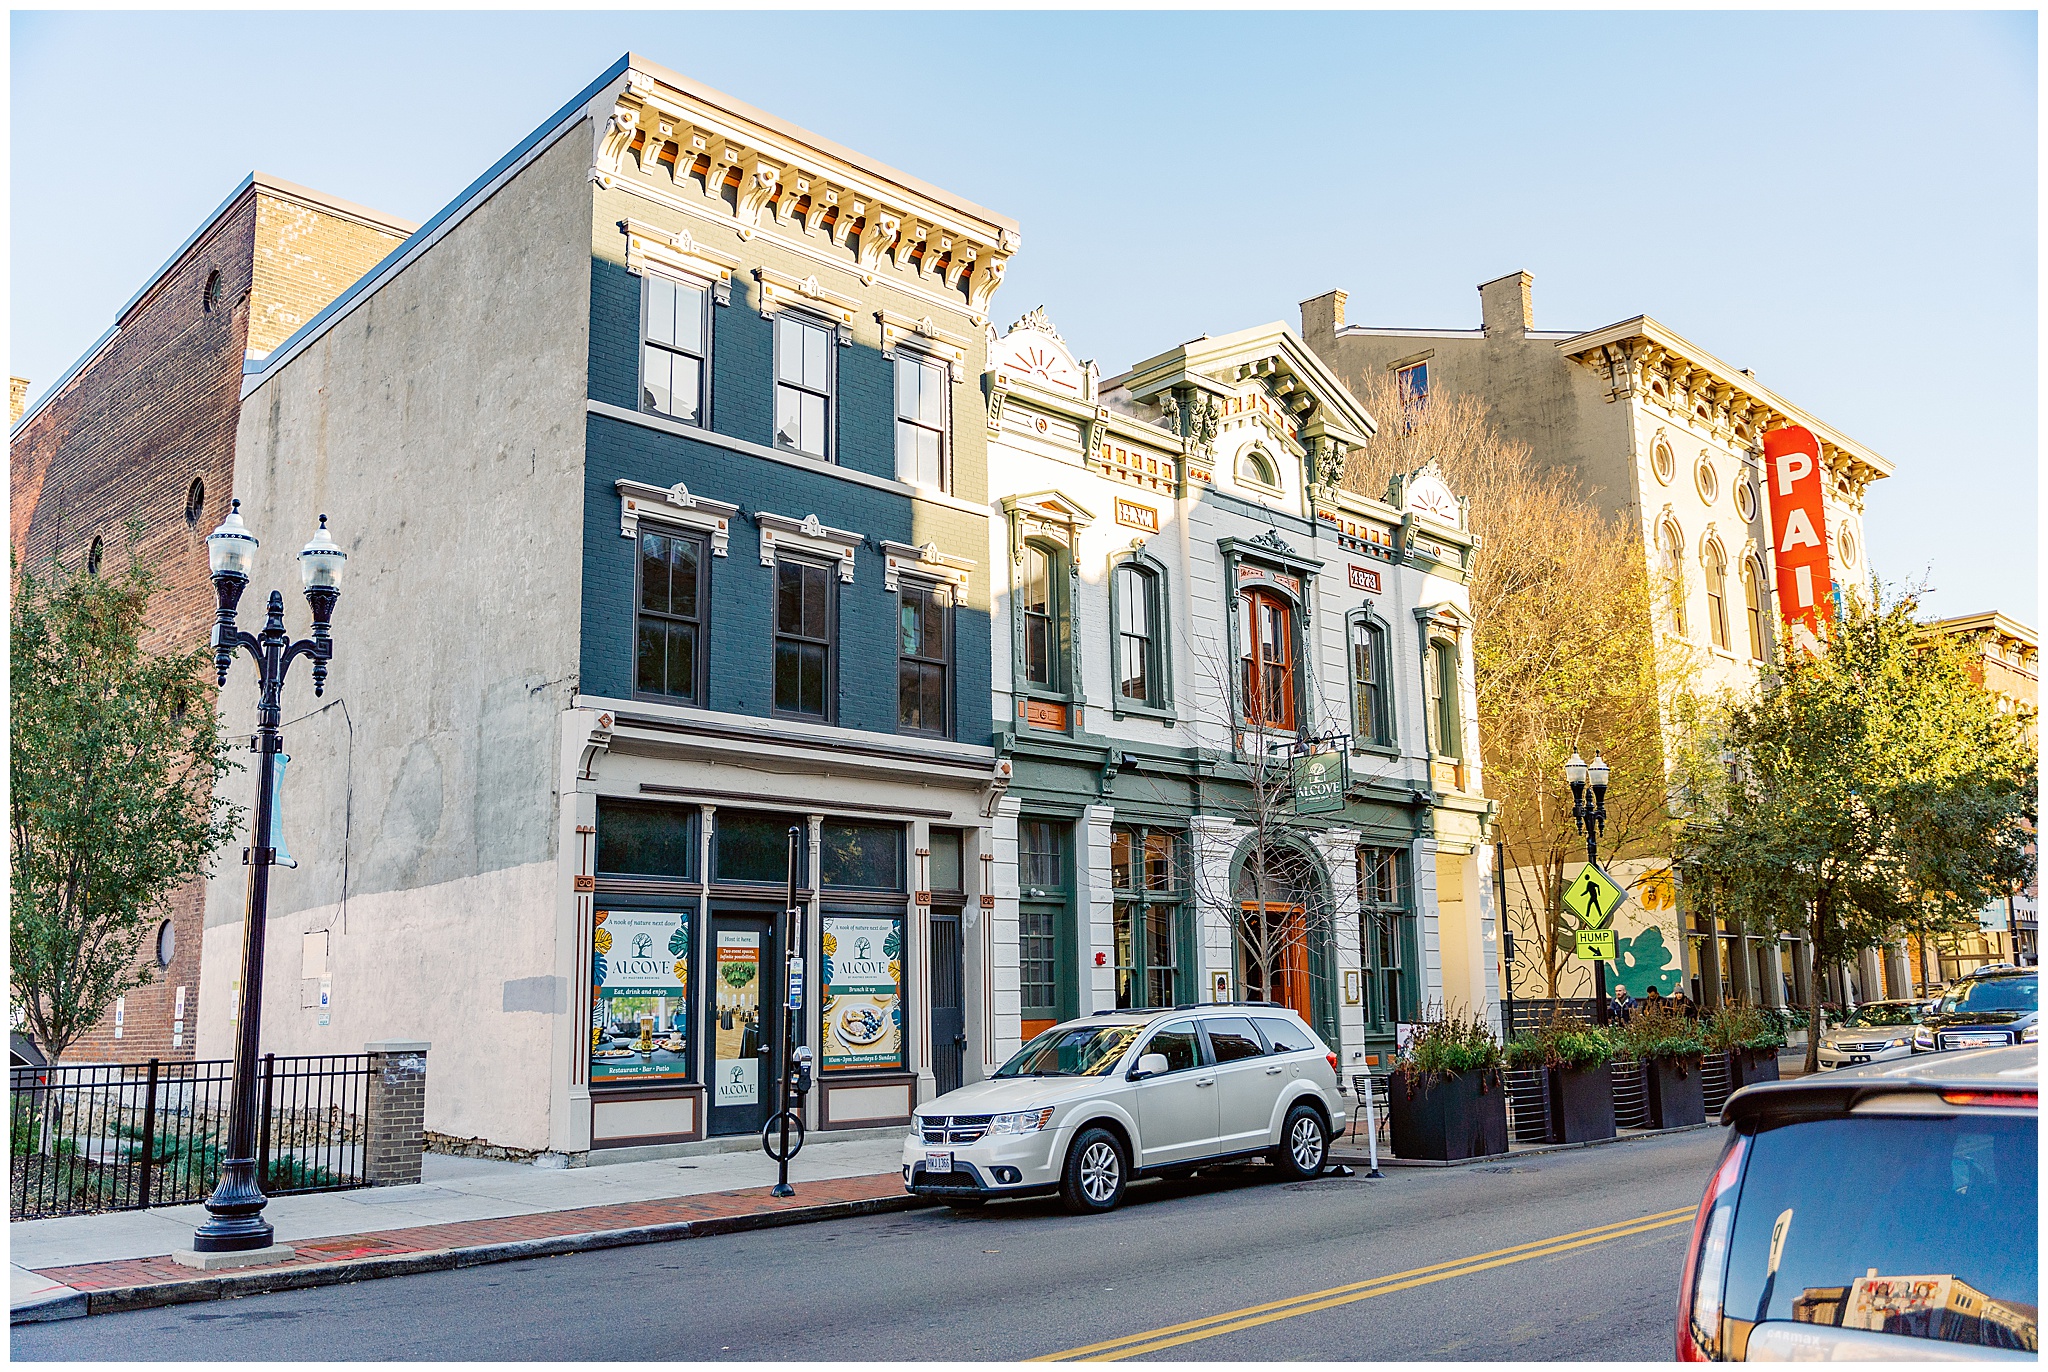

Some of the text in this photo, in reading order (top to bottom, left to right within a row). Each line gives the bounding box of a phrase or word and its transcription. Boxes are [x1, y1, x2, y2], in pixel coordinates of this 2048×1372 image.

[1775, 452, 1829, 662] PAIN
[1351, 570, 1376, 588] 1873
[1297, 782, 1340, 798] ALCOVE
[627, 919, 633, 927] of
[1580, 932, 1609, 942] HUMP
[613, 960, 670, 974] ALCOVE
[840, 962, 885, 974] ALCOVE
[719, 1084, 755, 1095] ALCOVE
